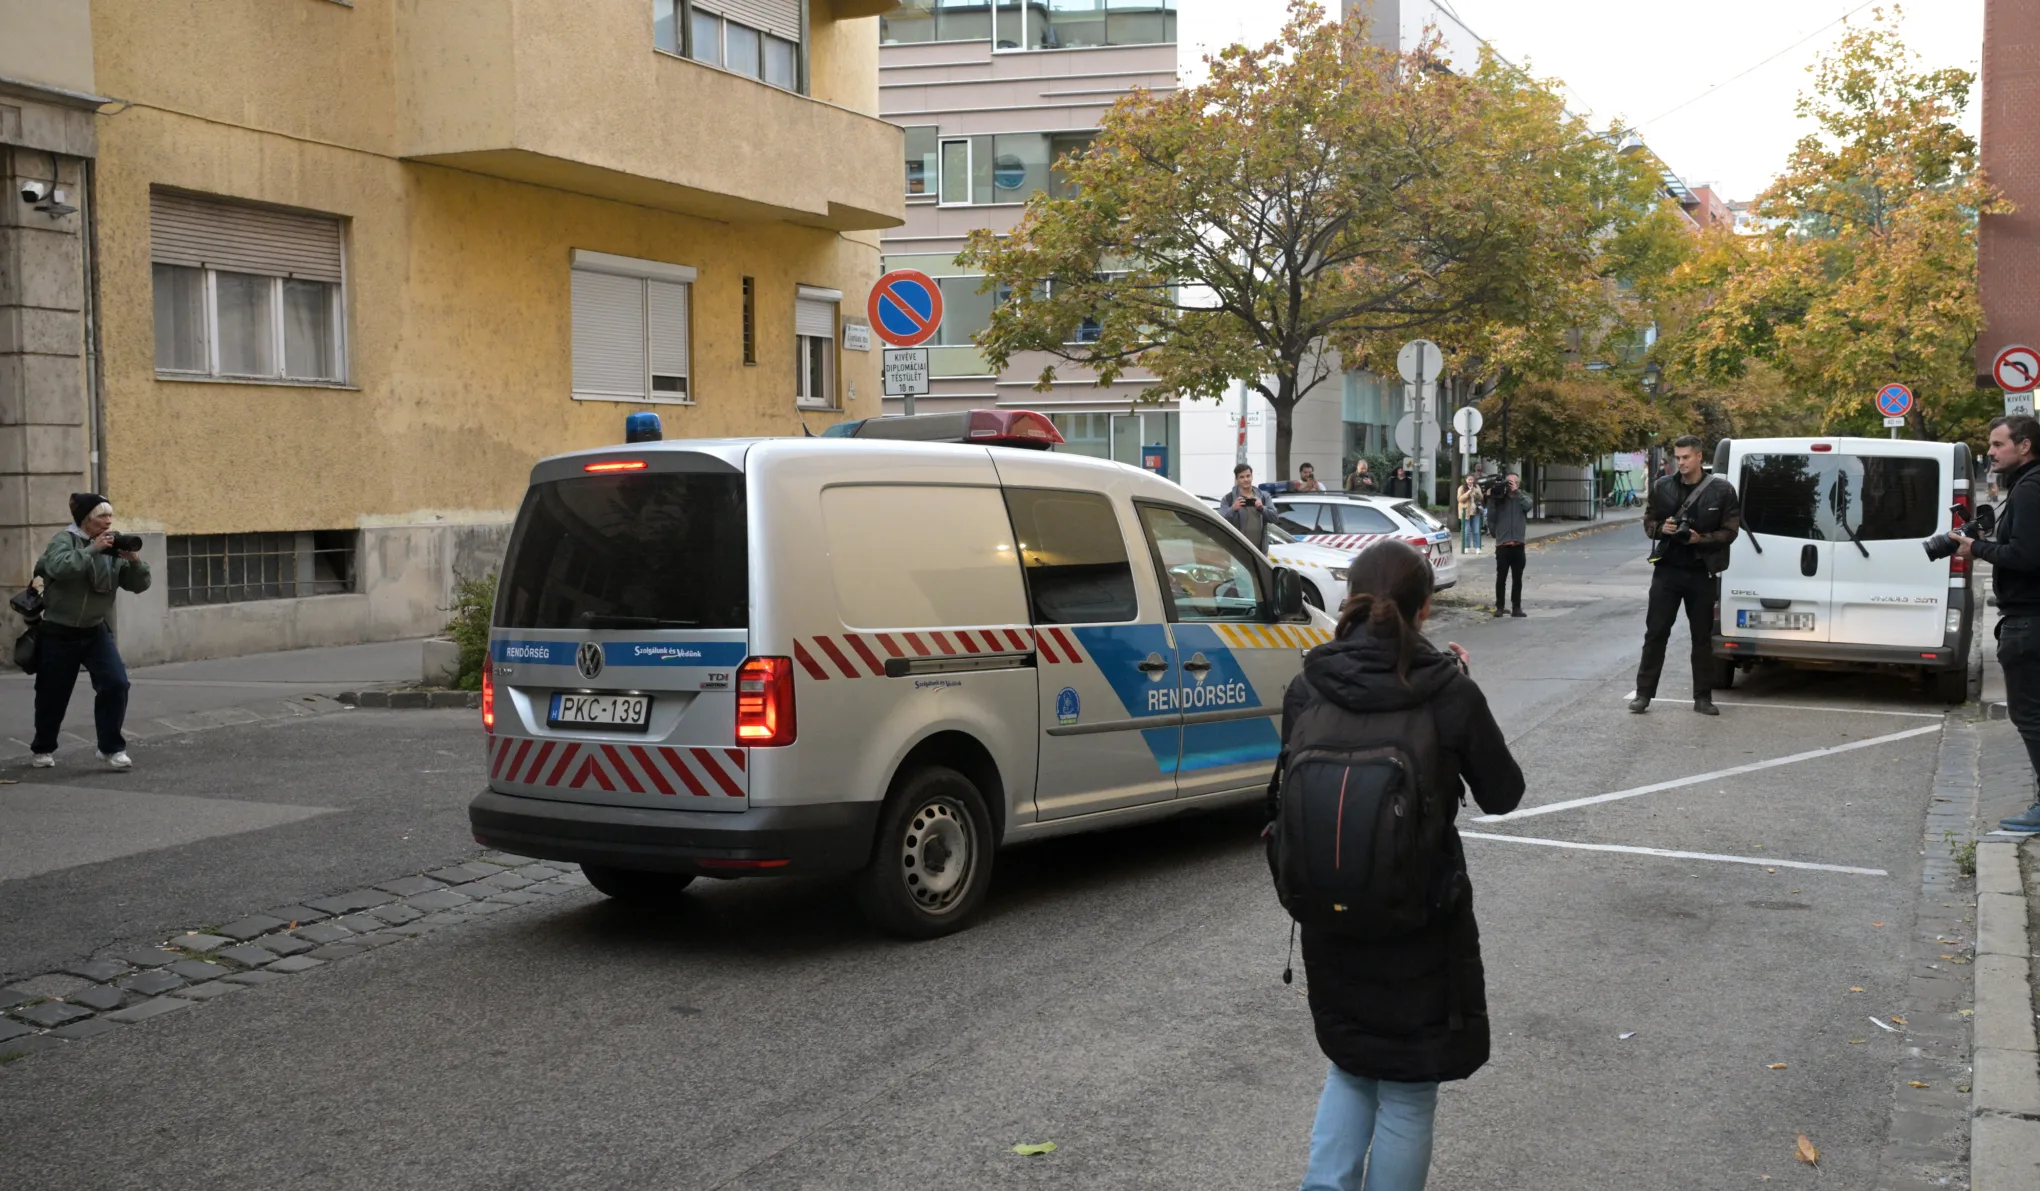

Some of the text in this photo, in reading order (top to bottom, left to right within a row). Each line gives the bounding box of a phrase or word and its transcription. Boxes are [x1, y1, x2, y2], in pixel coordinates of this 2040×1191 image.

[894, 352, 916, 362] KIVÉVE
[886, 362, 927, 372] DIPLOMÁCIAI
[899, 384, 907, 392] 10
[2007, 394, 2031, 402] KIVÉVE
[506, 645, 550, 659] RENDŐRSÉG
[708, 673, 729, 681] TDI
[1148, 679, 1246, 711] RENDŐRSÉG
[562, 698, 643, 722] PKC-139
